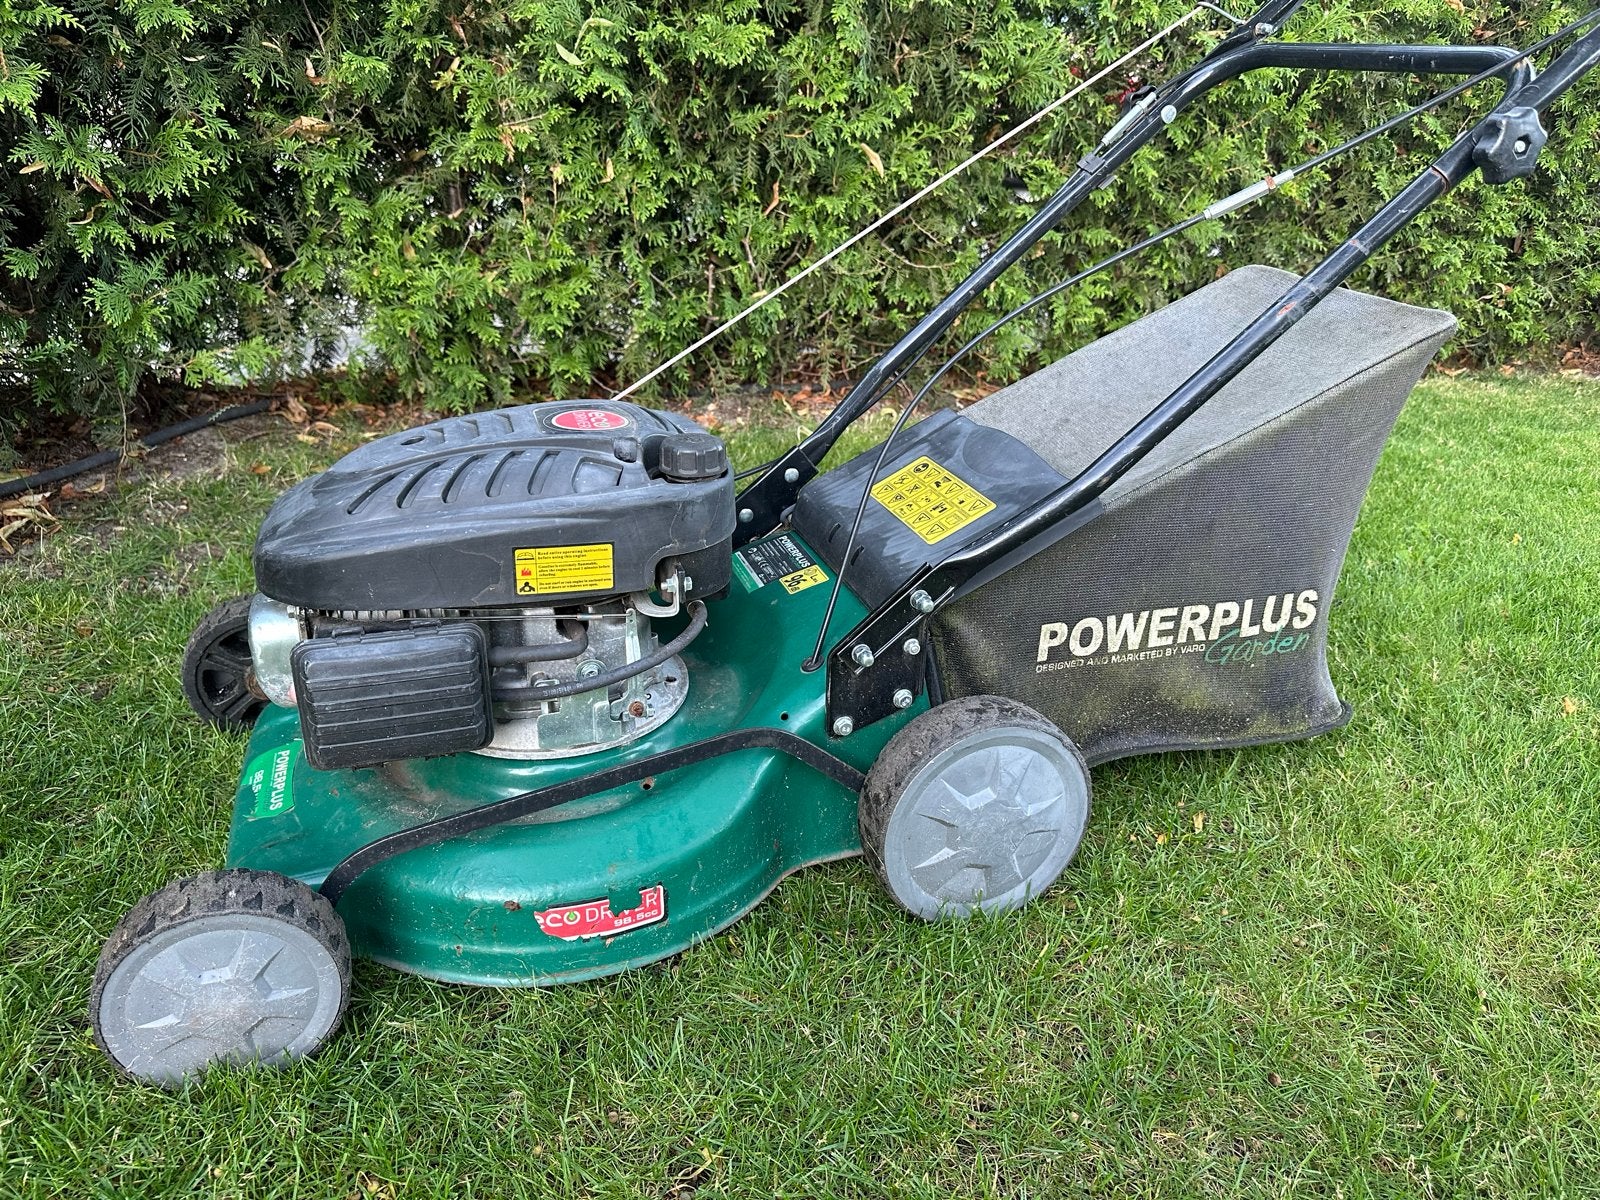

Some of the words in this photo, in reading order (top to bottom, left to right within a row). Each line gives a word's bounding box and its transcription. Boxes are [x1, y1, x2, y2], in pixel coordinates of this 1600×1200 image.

[779, 535, 811, 568] POWERPLUS
[784, 574, 807, 587] 96
[1036, 589, 1318, 662] POWERPLUS
[1036, 659, 1084, 673] DESIGNED
[1111, 650, 1164, 664] MARKETED
[1166, 647, 1178, 656] BY
[1181, 644, 1206, 654] VARO
[1204, 626, 1310, 666] Garden
[270, 750, 290, 810] POWERPLUS
